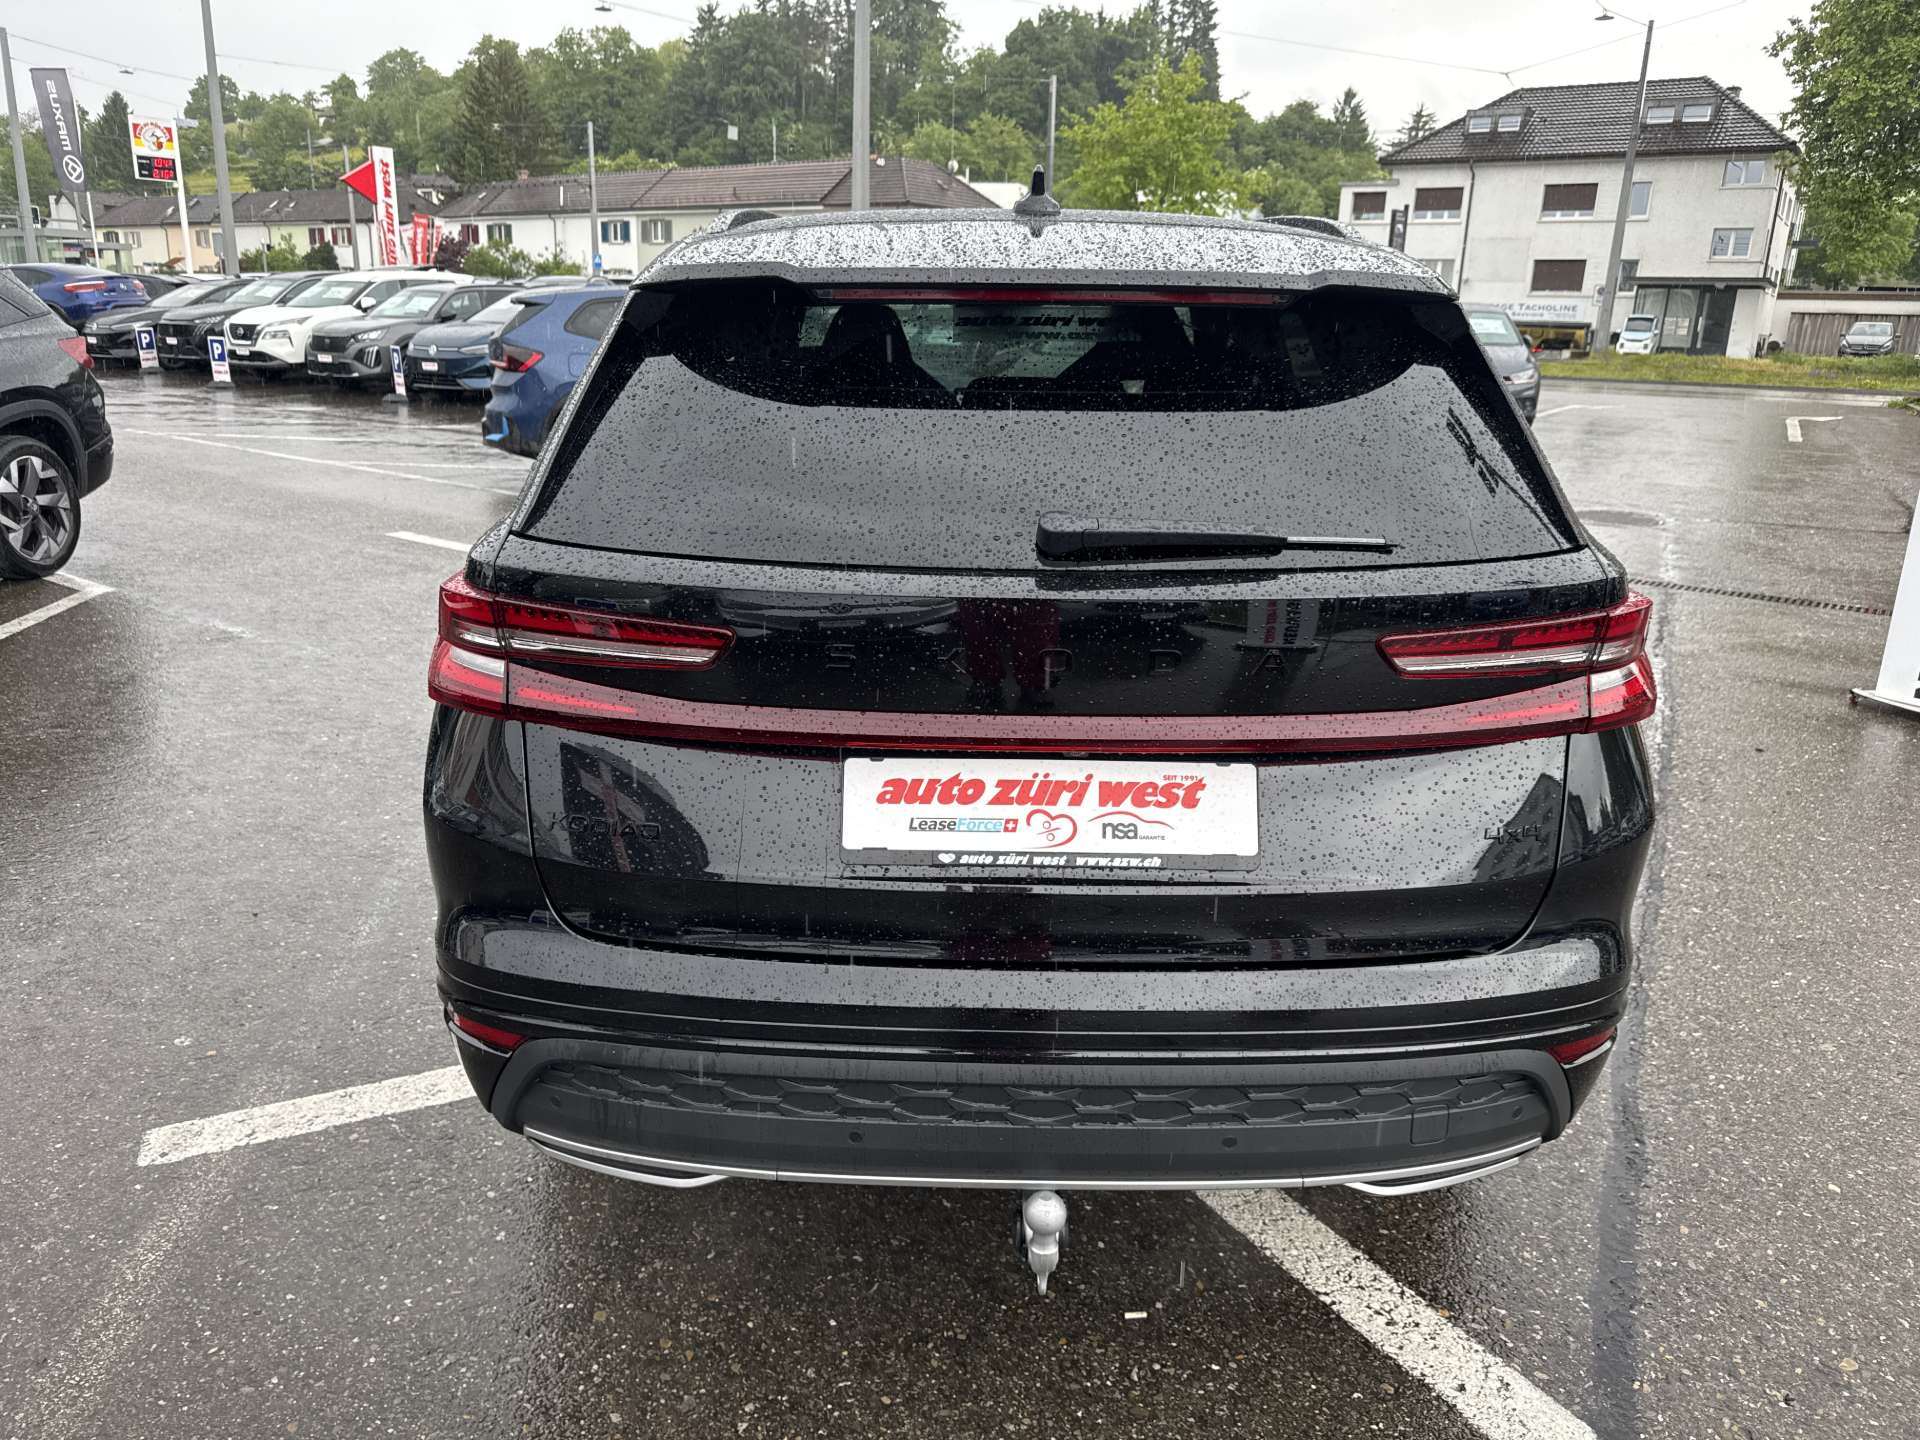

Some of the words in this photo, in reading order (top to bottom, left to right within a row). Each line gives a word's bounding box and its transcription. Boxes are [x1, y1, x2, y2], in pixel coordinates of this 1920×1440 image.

[380, 159, 392, 198] west
[1518, 303, 1579, 313] TACHOLINE
[140, 332, 150, 349] P
[212, 341, 222, 360] P
[1179, 774, 1199, 782] 1991
[875, 771, 986, 806] auto
[987, 772, 1094, 807] züri
[1098, 775, 1207, 810] west
[908, 817, 1003, 833] LeaseForce
[1101, 822, 1138, 841] nsa
[959, 853, 994, 866] auto
[996, 852, 1029, 866] züri
[1032, 854, 1067, 867] west
[1075, 855, 1161, 869] www.azw.ch
